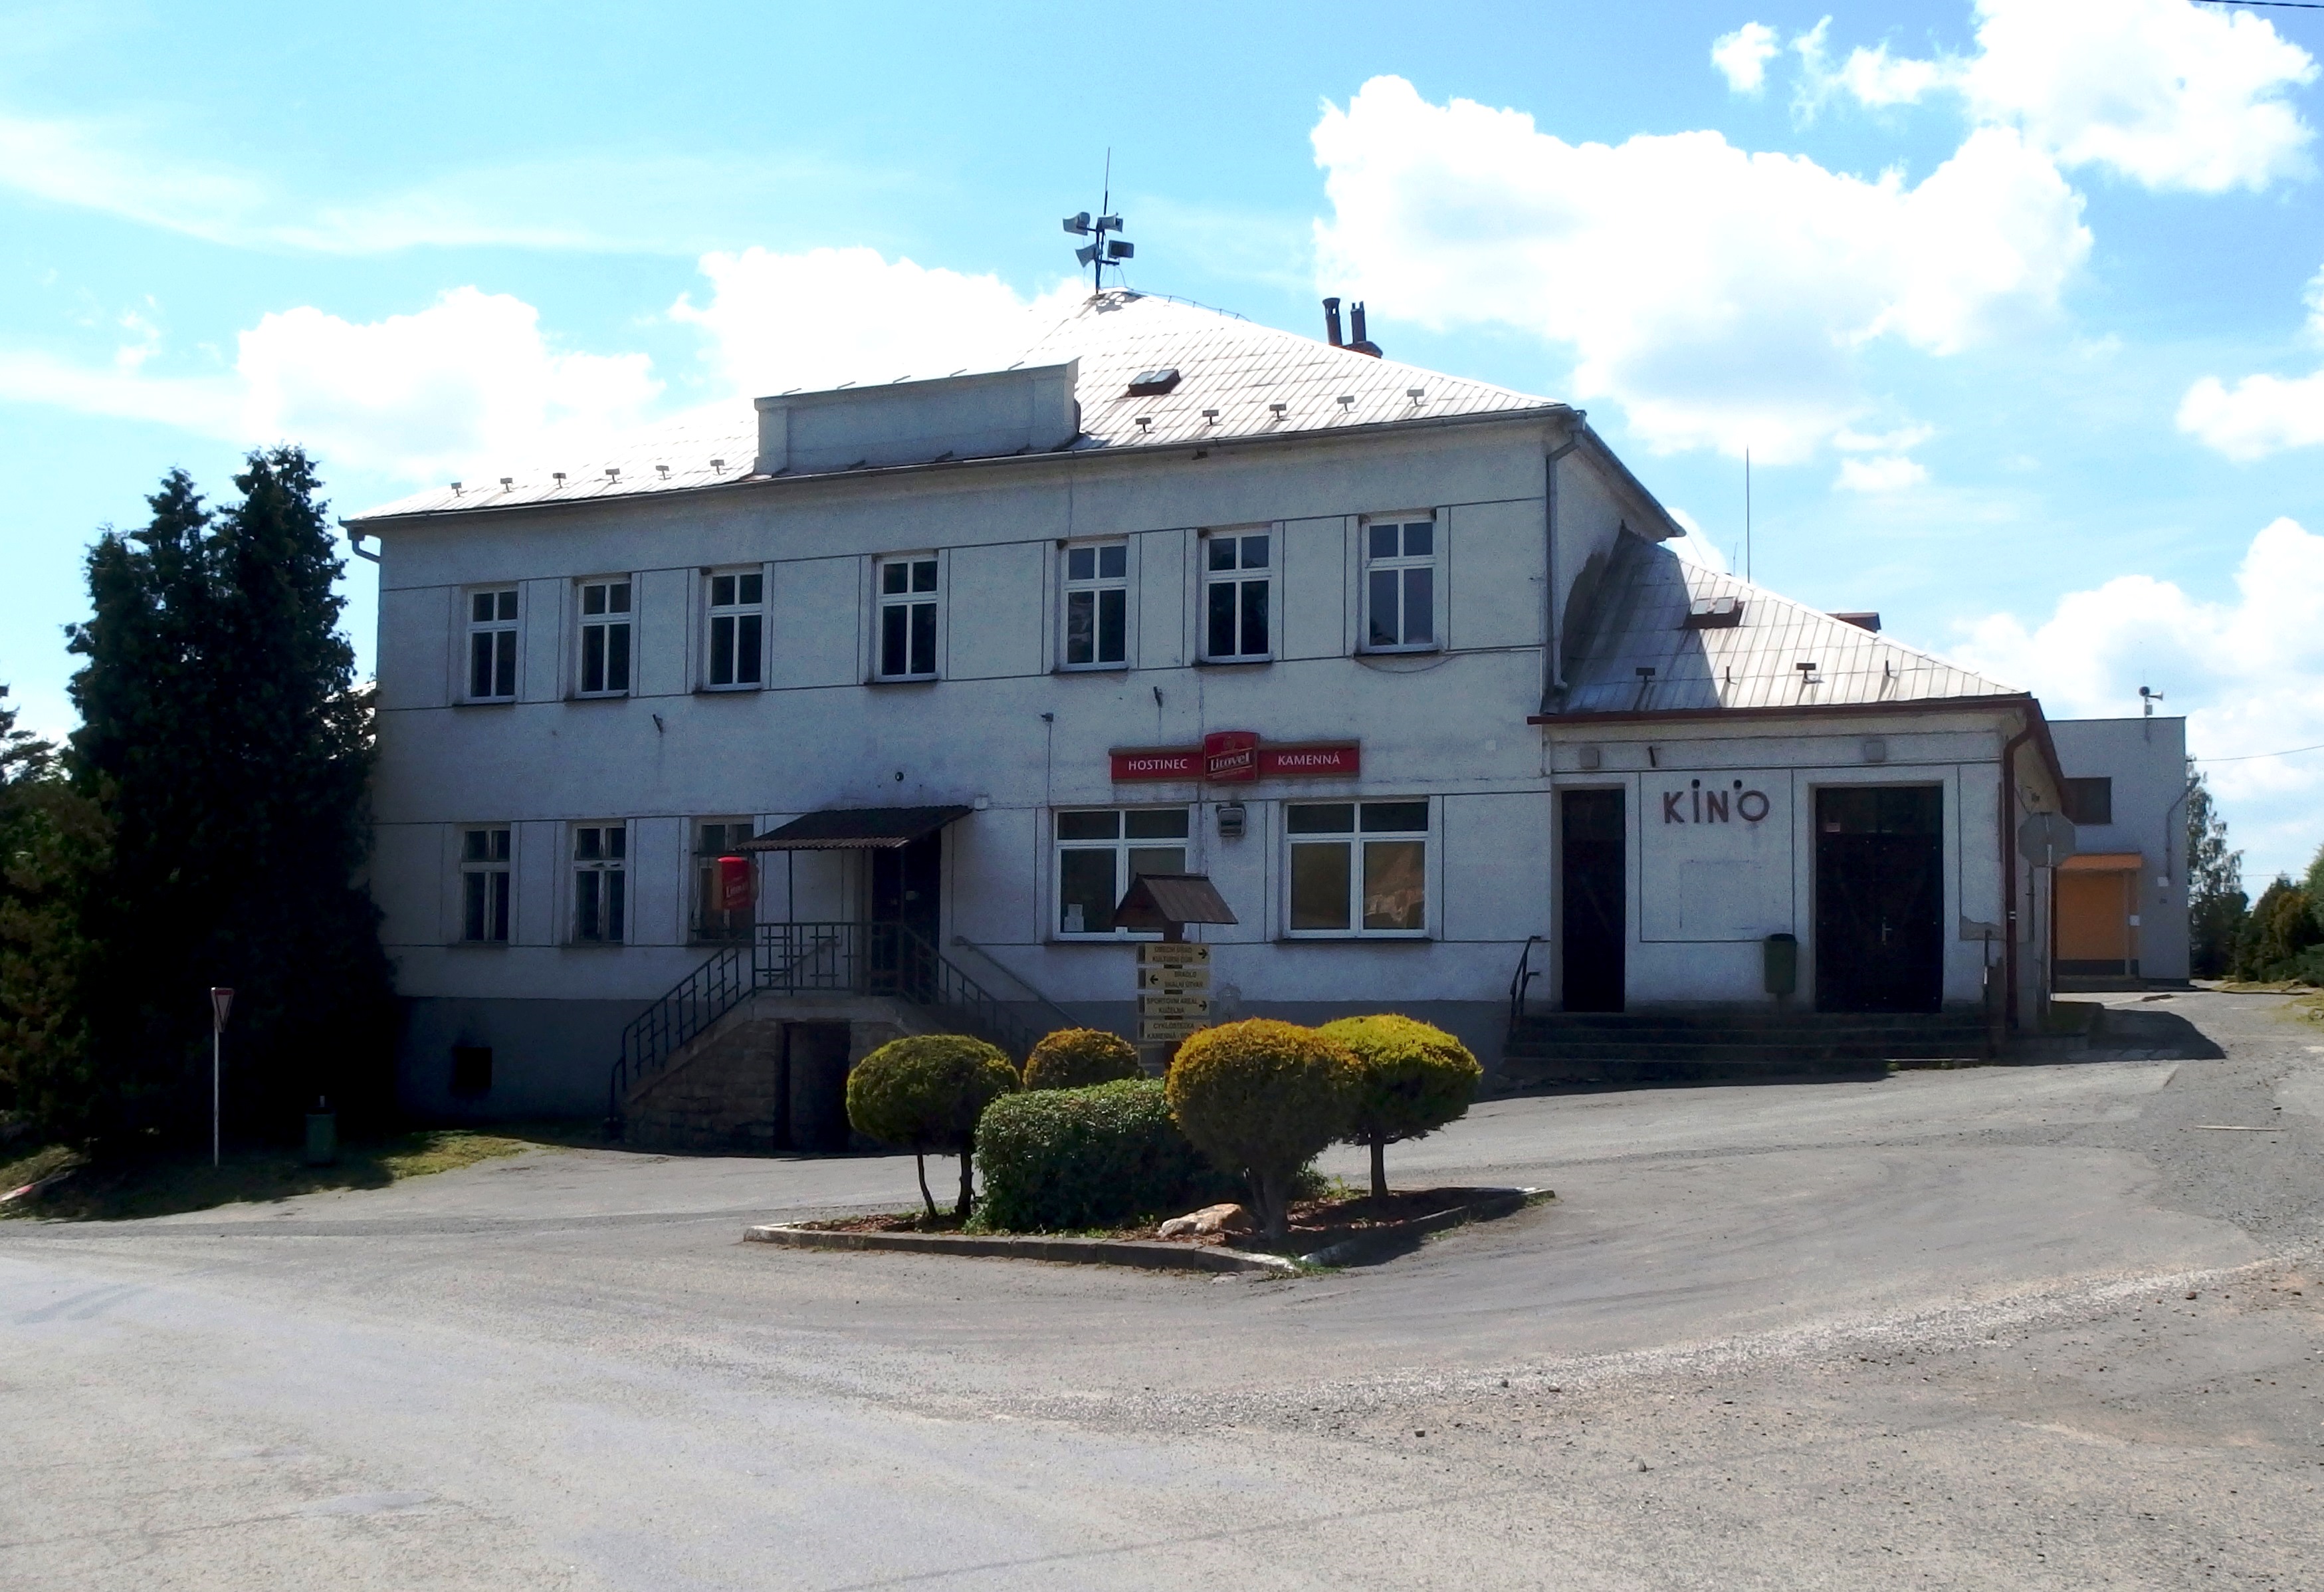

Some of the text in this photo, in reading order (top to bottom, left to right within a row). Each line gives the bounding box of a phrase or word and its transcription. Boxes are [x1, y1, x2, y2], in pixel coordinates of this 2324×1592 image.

[1128, 758, 1188, 770] HOSTINEC
[1277, 752, 1341, 766] KAMENNÁ
[1663, 787, 1770, 824] KINO
